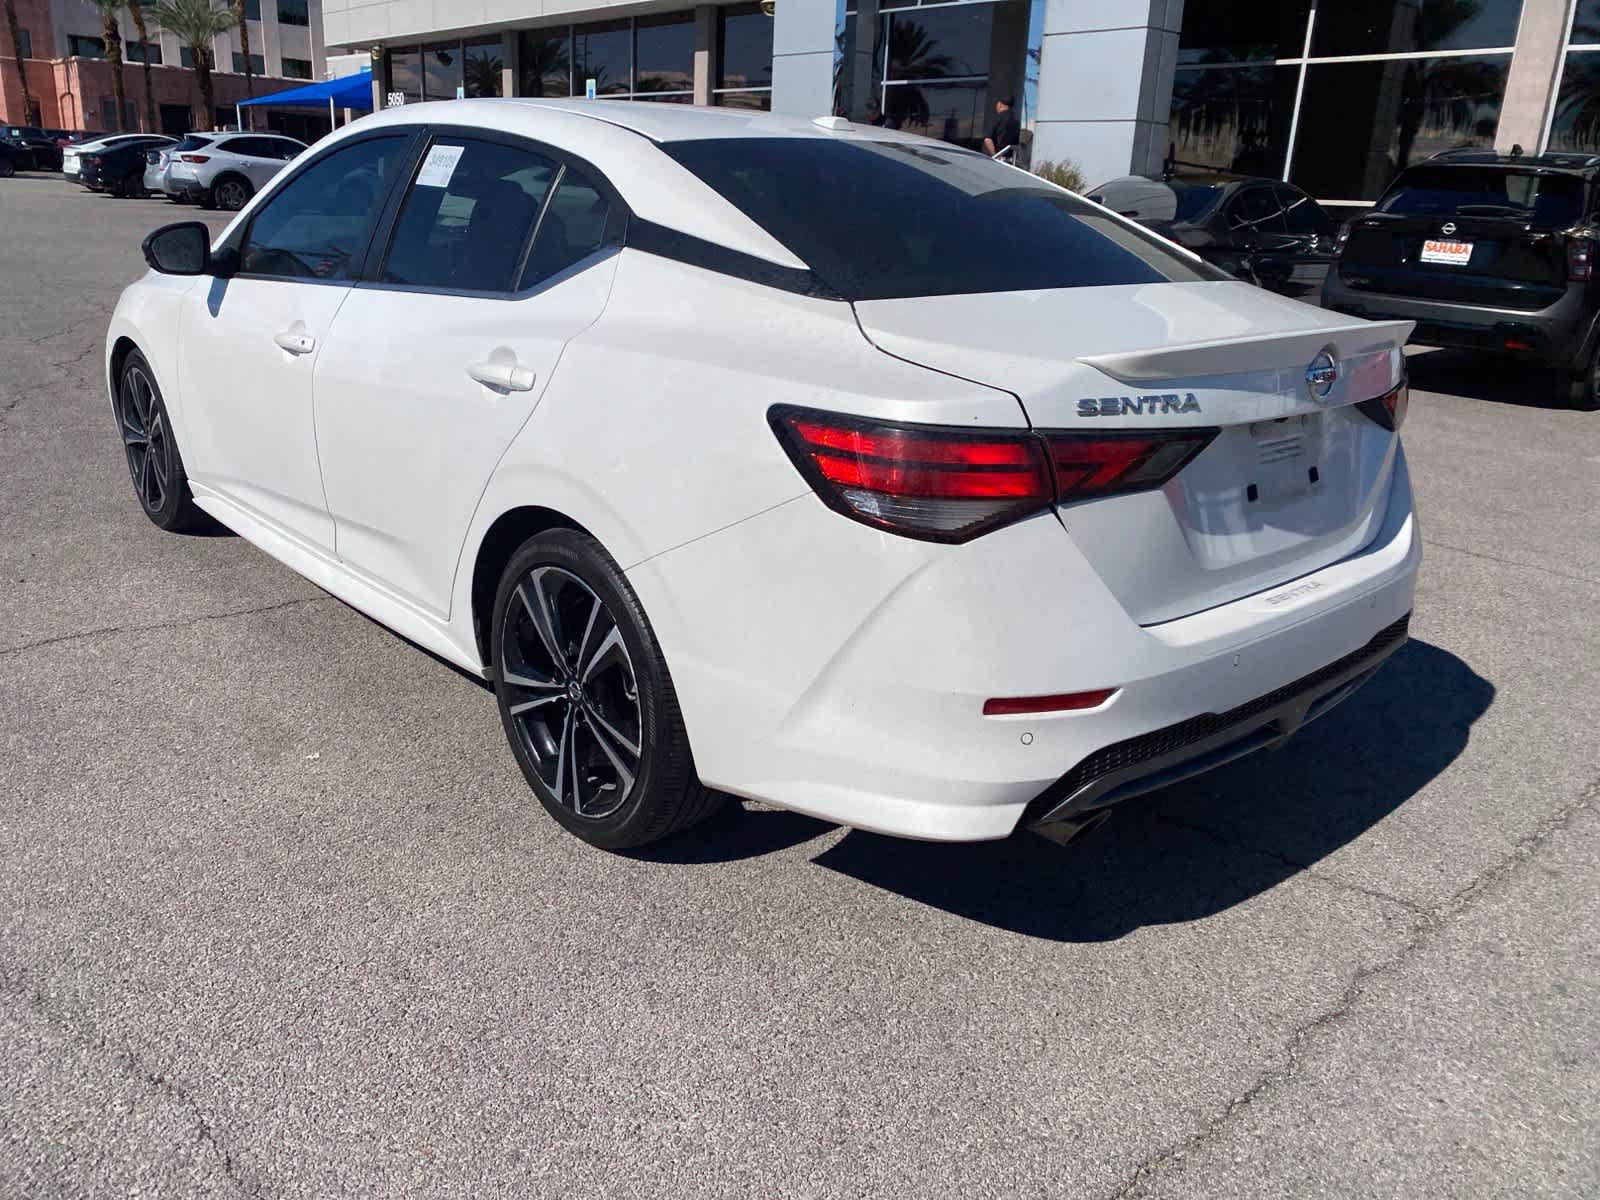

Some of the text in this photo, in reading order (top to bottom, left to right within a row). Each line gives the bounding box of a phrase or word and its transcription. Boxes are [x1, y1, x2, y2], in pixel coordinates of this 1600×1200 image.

[1424, 241, 1470, 255] SAHARA
[1076, 392, 1202, 417] SENTRA
[1264, 581, 1324, 606] SENTRA
